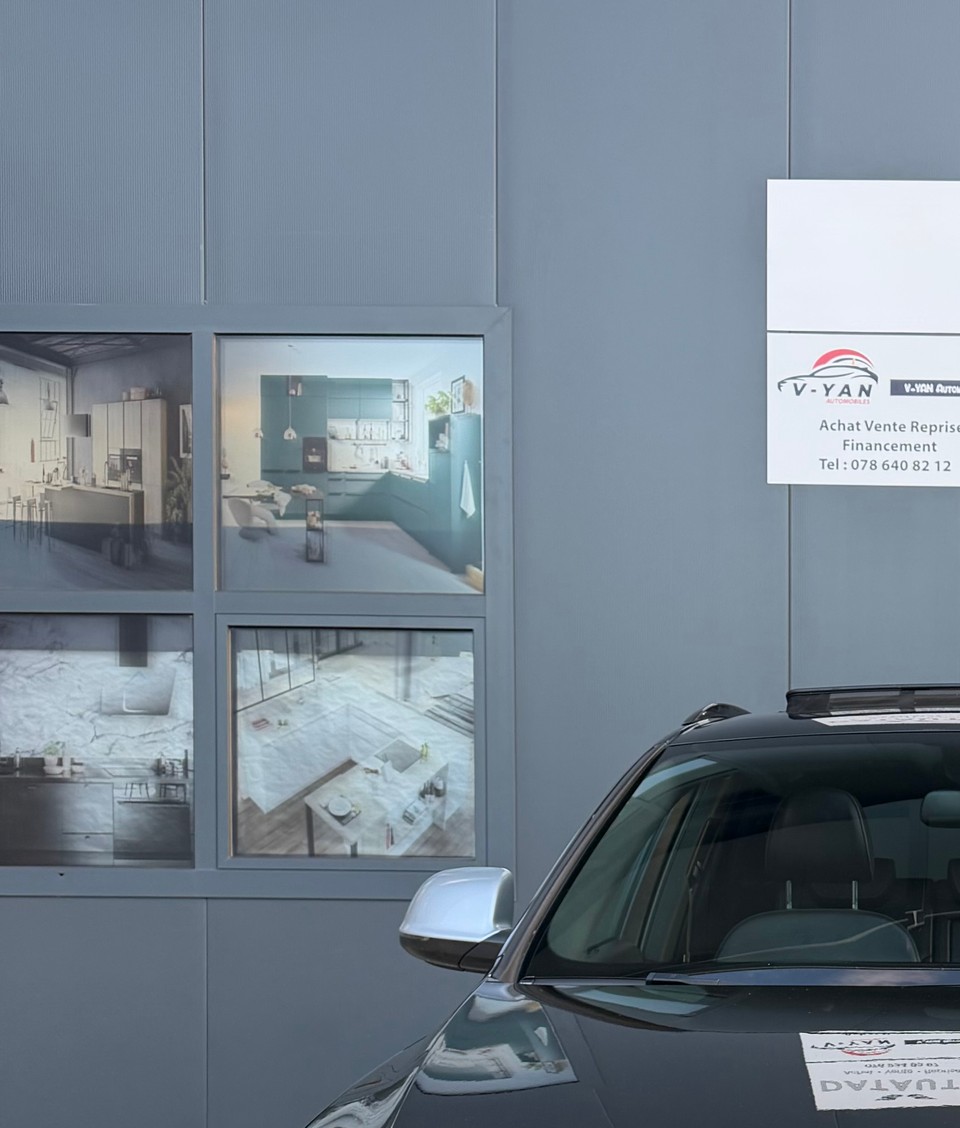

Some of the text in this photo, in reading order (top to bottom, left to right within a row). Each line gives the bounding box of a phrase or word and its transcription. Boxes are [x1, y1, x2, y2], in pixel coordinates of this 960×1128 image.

[793, 383, 873, 398] V-YAN
[904, 383, 934, 393] V-YAN
[819, 419, 861, 432] Achat
[864, 420, 907, 432] Vente
[842, 439, 938, 452] Financement
[851, 459, 878, 471] 078
[881, 459, 908, 471] 640
[912, 460, 930, 471] 82
[935, 460, 951, 472] 12
